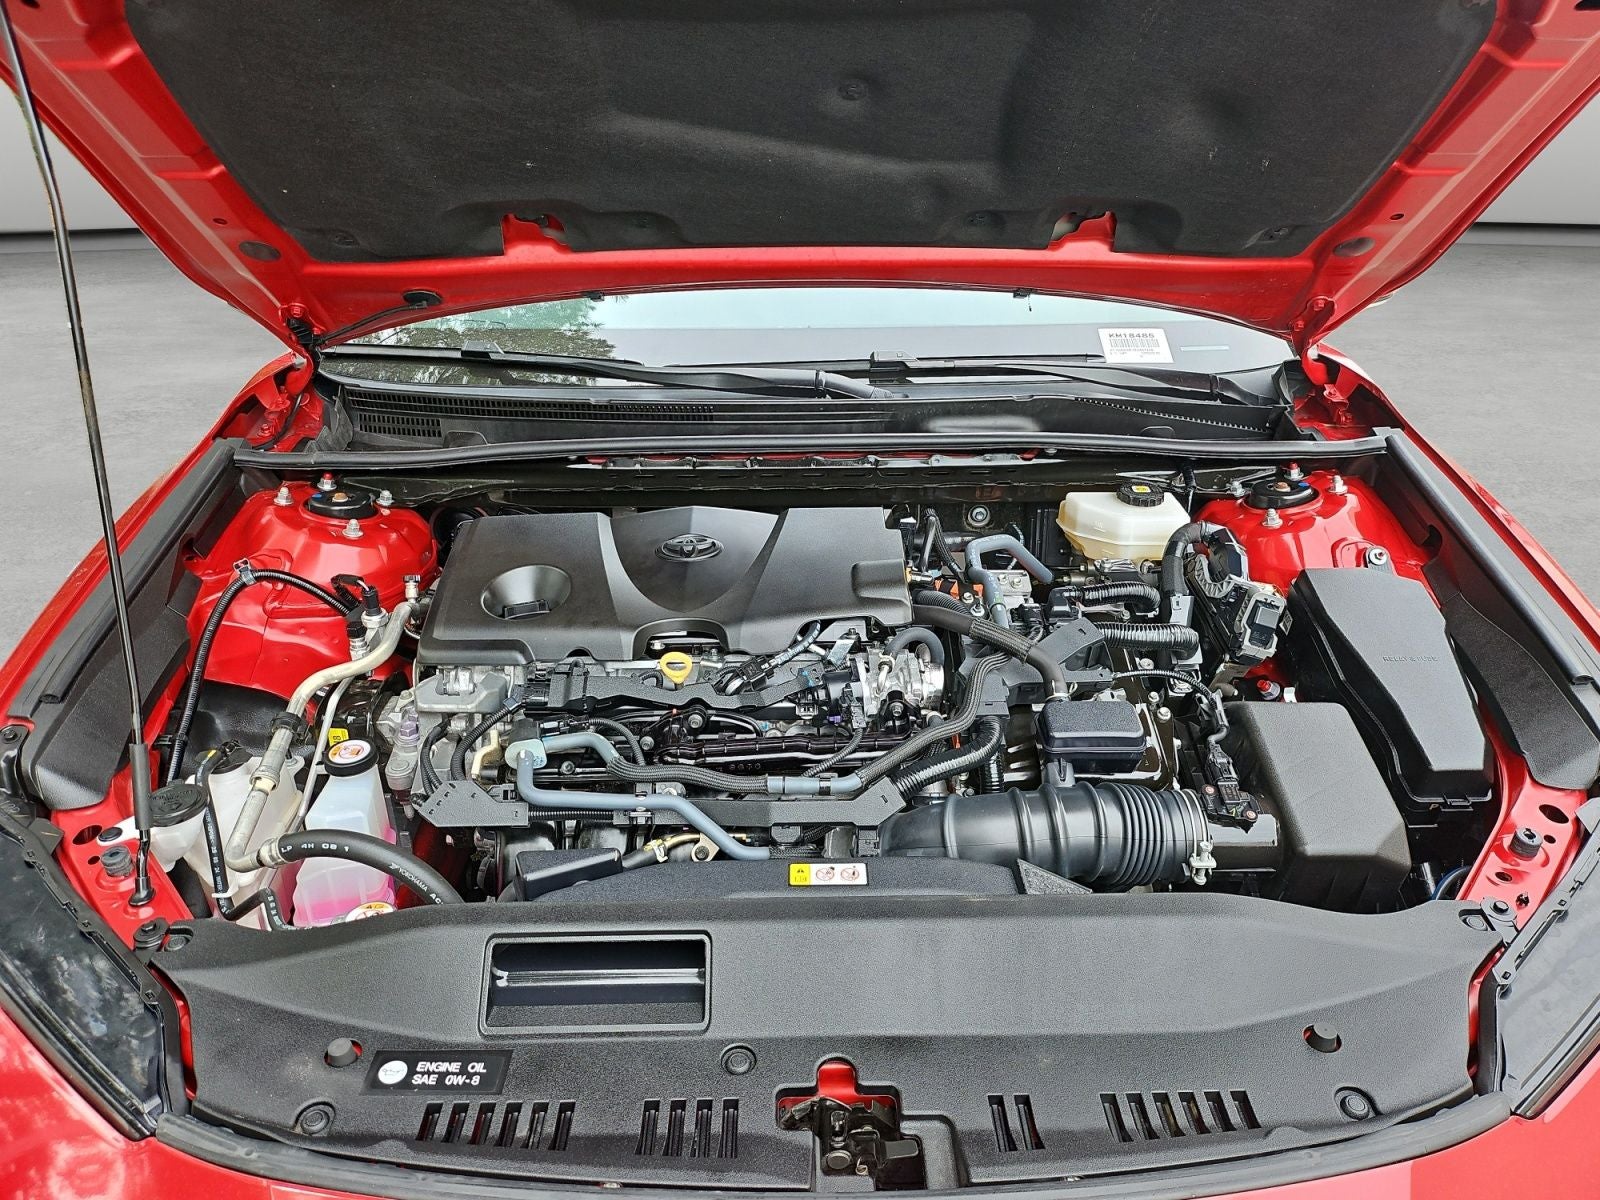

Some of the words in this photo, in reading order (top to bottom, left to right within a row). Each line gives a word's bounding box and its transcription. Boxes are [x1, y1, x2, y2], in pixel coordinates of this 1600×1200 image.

[398, 866, 428, 892] YOKOHAMA
[429, 892, 444, 905] AC
[415, 1061, 461, 1073] ENGINE
[467, 1061, 487, 1073] OIL
[411, 1074, 439, 1085] SAE
[444, 1074, 480, 1086] 0W-8
